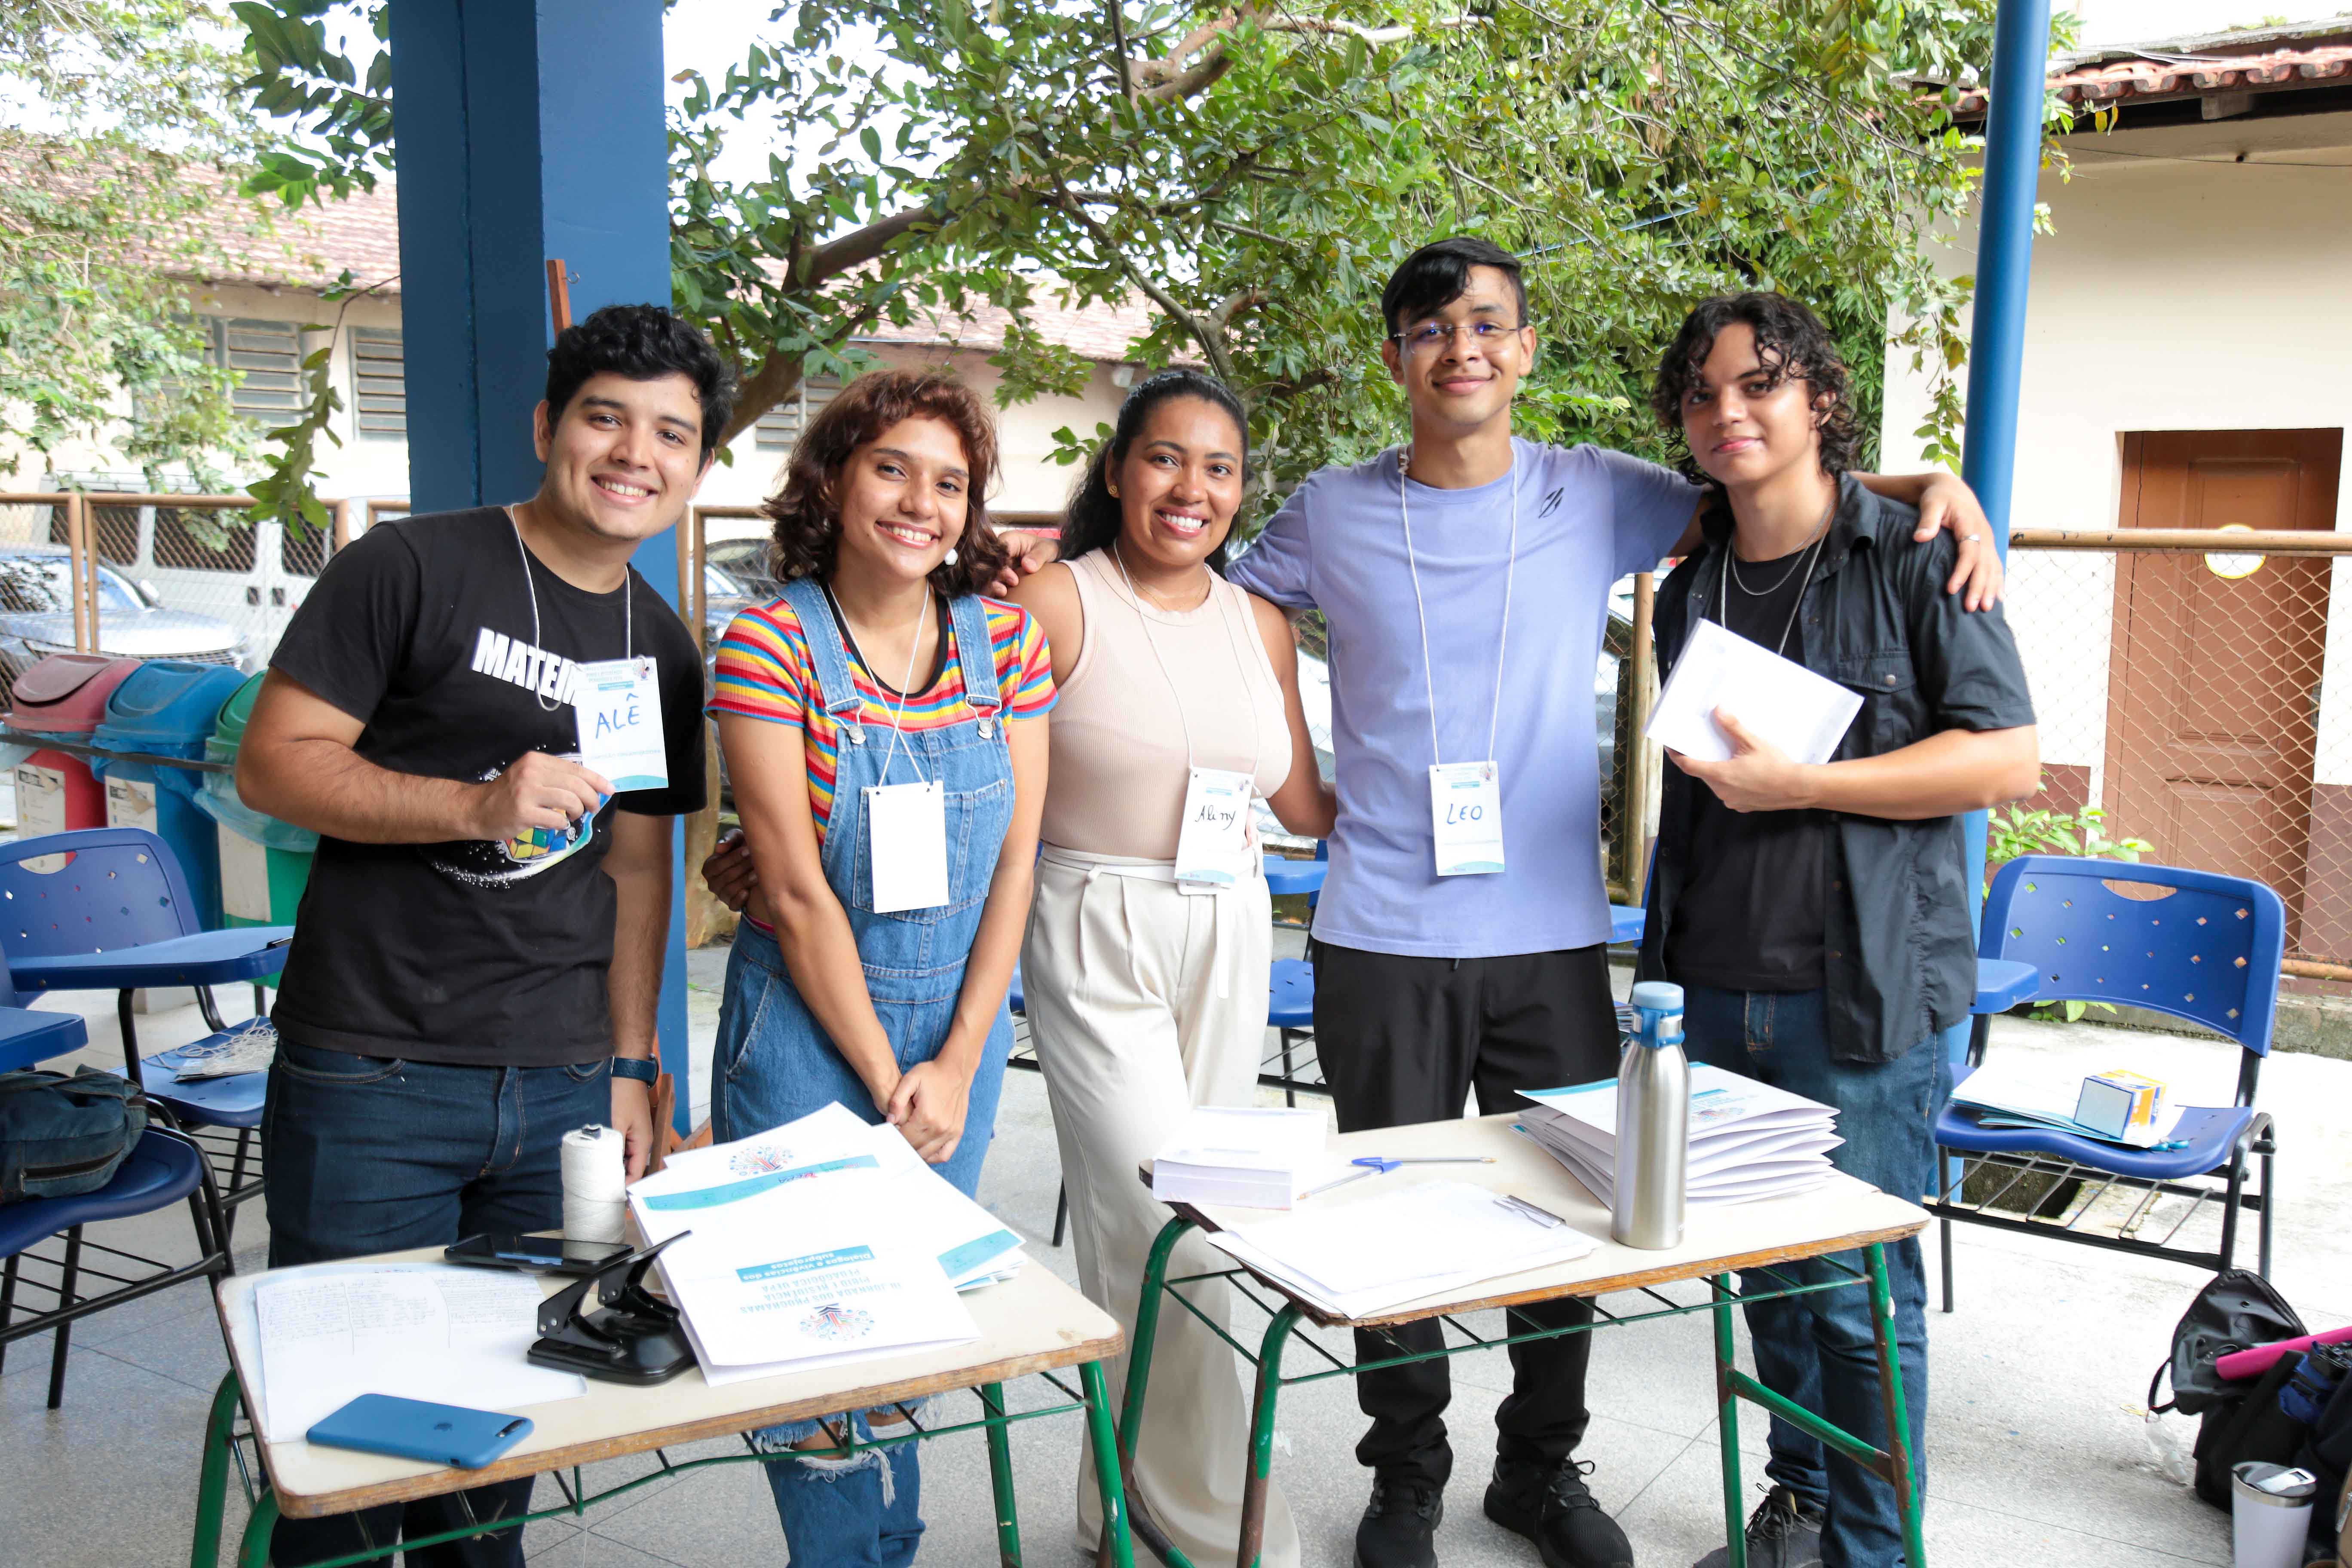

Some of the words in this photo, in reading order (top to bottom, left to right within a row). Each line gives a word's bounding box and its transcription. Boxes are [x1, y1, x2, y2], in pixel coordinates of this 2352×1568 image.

[1447, 803, 1482, 824] LEO
[770, 1252, 835, 1269] subprojetos
[761, 1282, 791, 1293] UEPA
[840, 1276, 870, 1287] PIBID
[812, 1292, 835, 1302] DOS
[836, 1283, 886, 1297] JORNADA
[740, 1297, 810, 1314] PROGRAMAS
